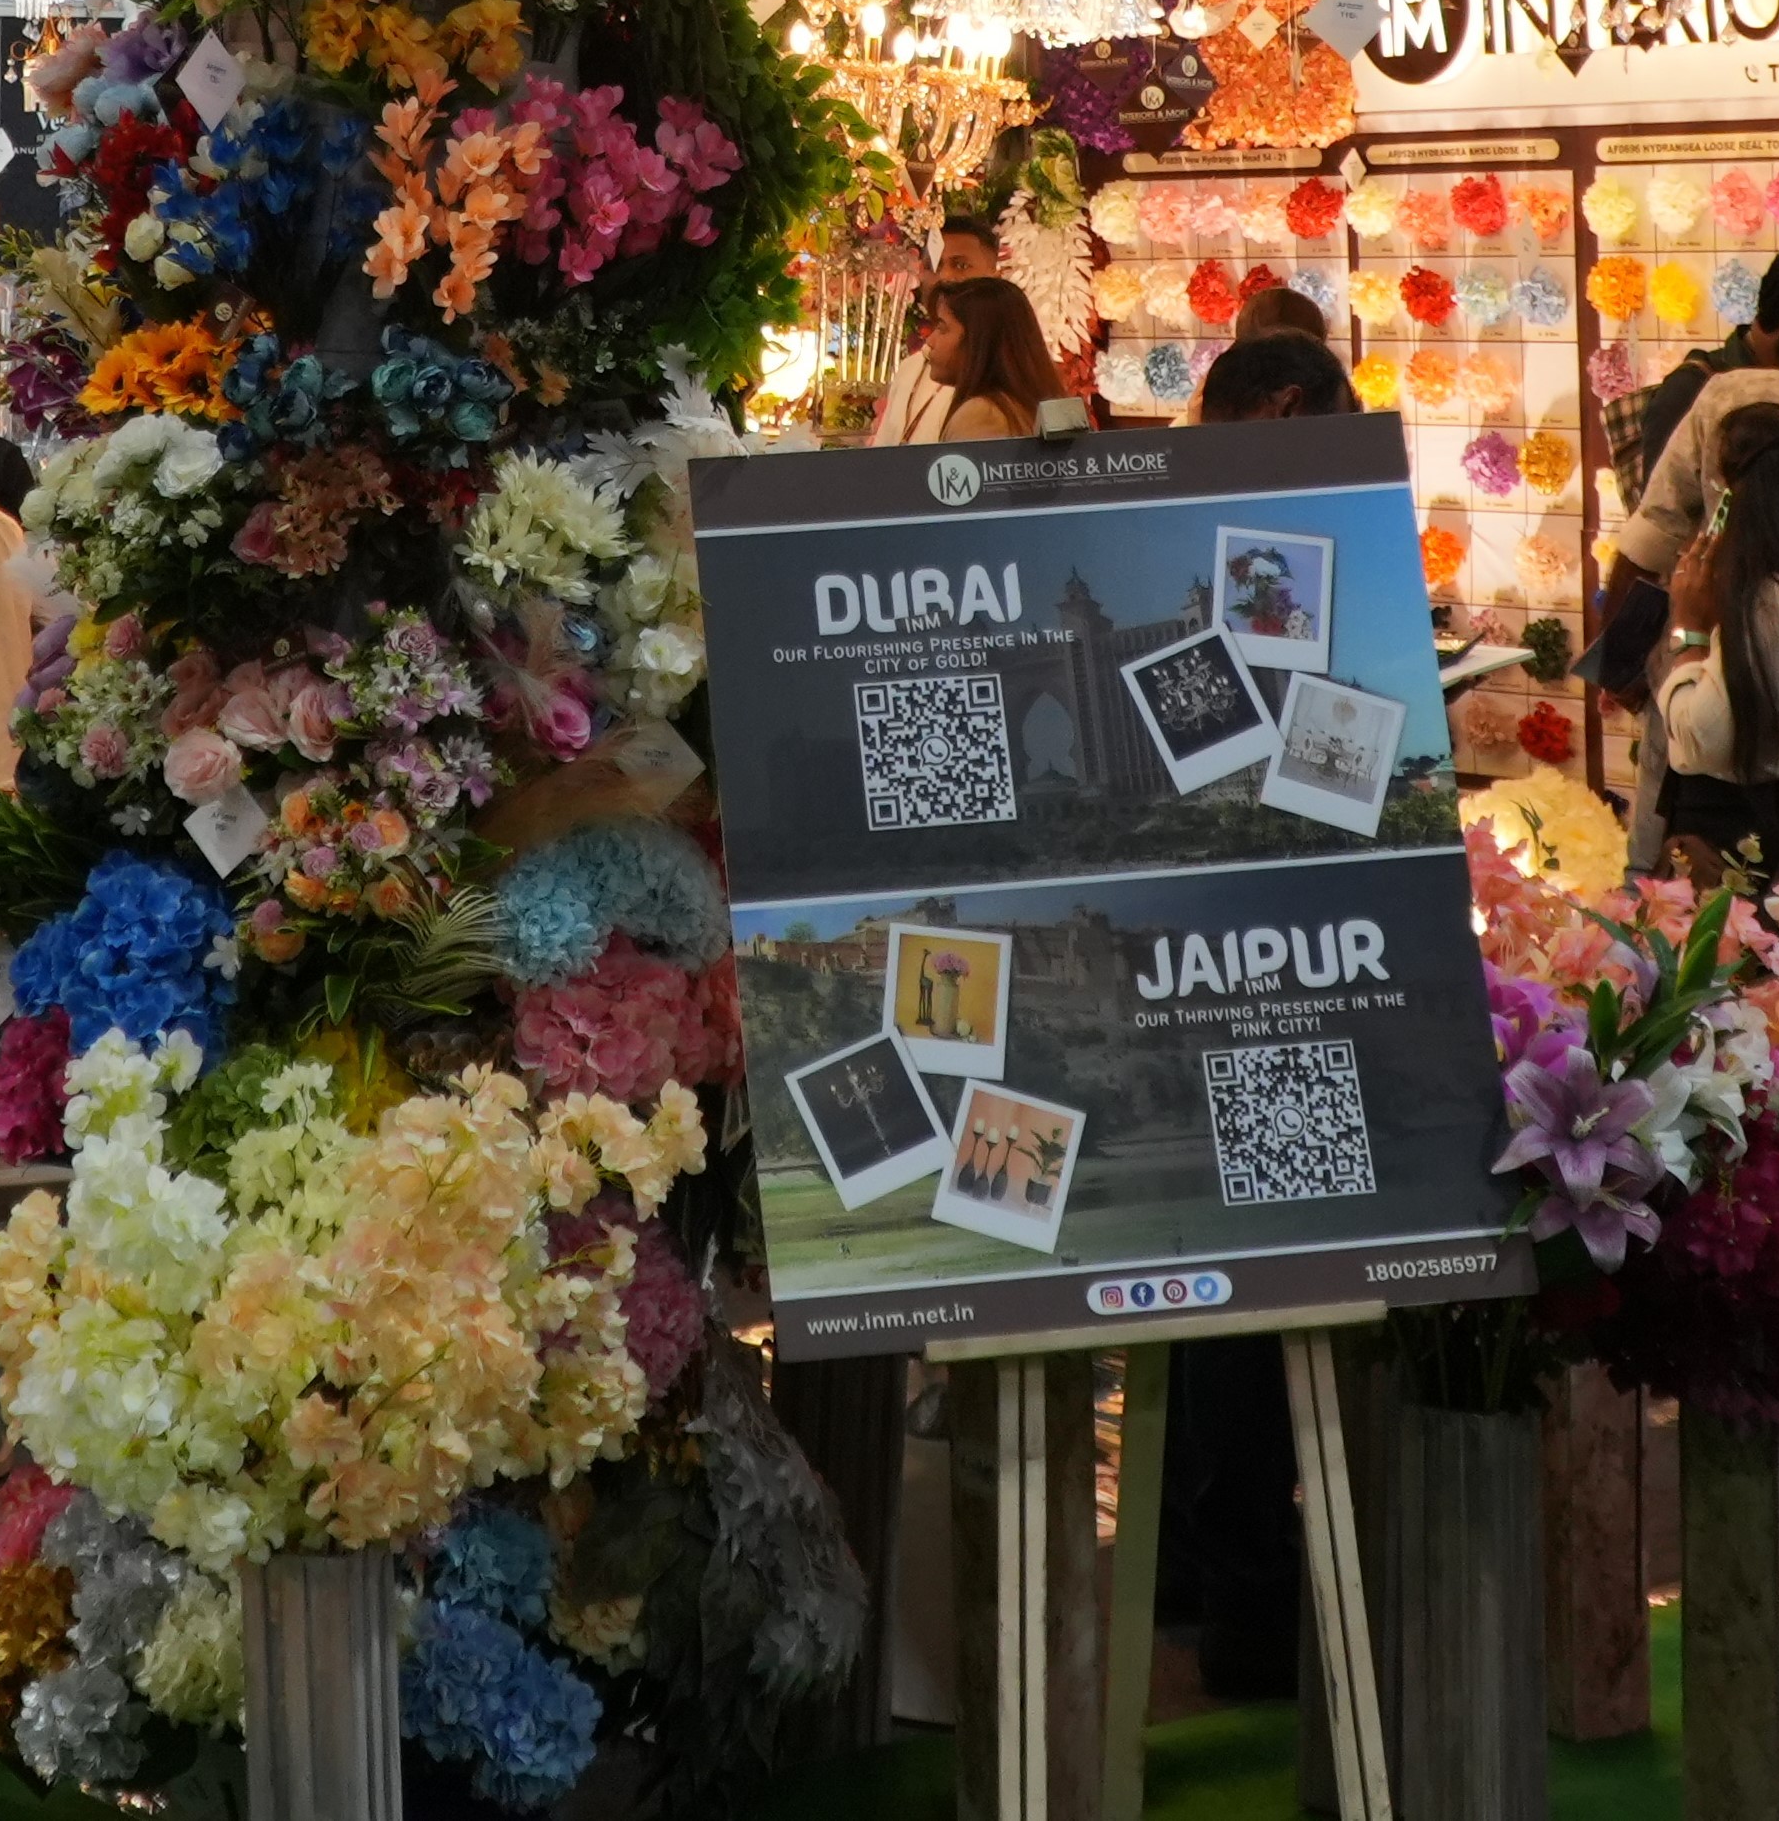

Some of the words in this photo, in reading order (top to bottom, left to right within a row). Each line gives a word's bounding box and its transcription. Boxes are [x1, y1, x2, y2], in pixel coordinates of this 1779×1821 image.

[983, 459, 1079, 482] INTERIORS
[1086, 457, 1100, 475] &
[1107, 452, 1167, 473] MORE
[905, 613, 941, 634] INM
[773, 647, 808, 663] OUR
[814, 640, 924, 661] FLOURISHING
[930, 633, 1016, 653] PRESENCE
[1021, 630, 1038, 646] IN
[1042, 629, 1075, 645] THE
[865, 658, 901, 674] CITY
[908, 656, 930, 671] OF
[936, 652, 988, 669] GOLD!
[1136, 919, 1391, 1000] JAIPUR
[1245, 973, 1282, 996] INM
[1135, 1012, 1169, 1028] OUR
[1176, 1005, 1254, 1025] THRIVING
[1260, 997, 1345, 1017] PRESENCE
[1351, 995, 1369, 1010] IN
[1374, 993, 1406, 1008] THE
[1231, 1019, 1272, 1039] PINK
[1277, 1016, 1322, 1035] CITY!
[1365, 1252, 1498, 1283] 18002585977
[807, 1303, 975, 1336] www.inm.net.in
